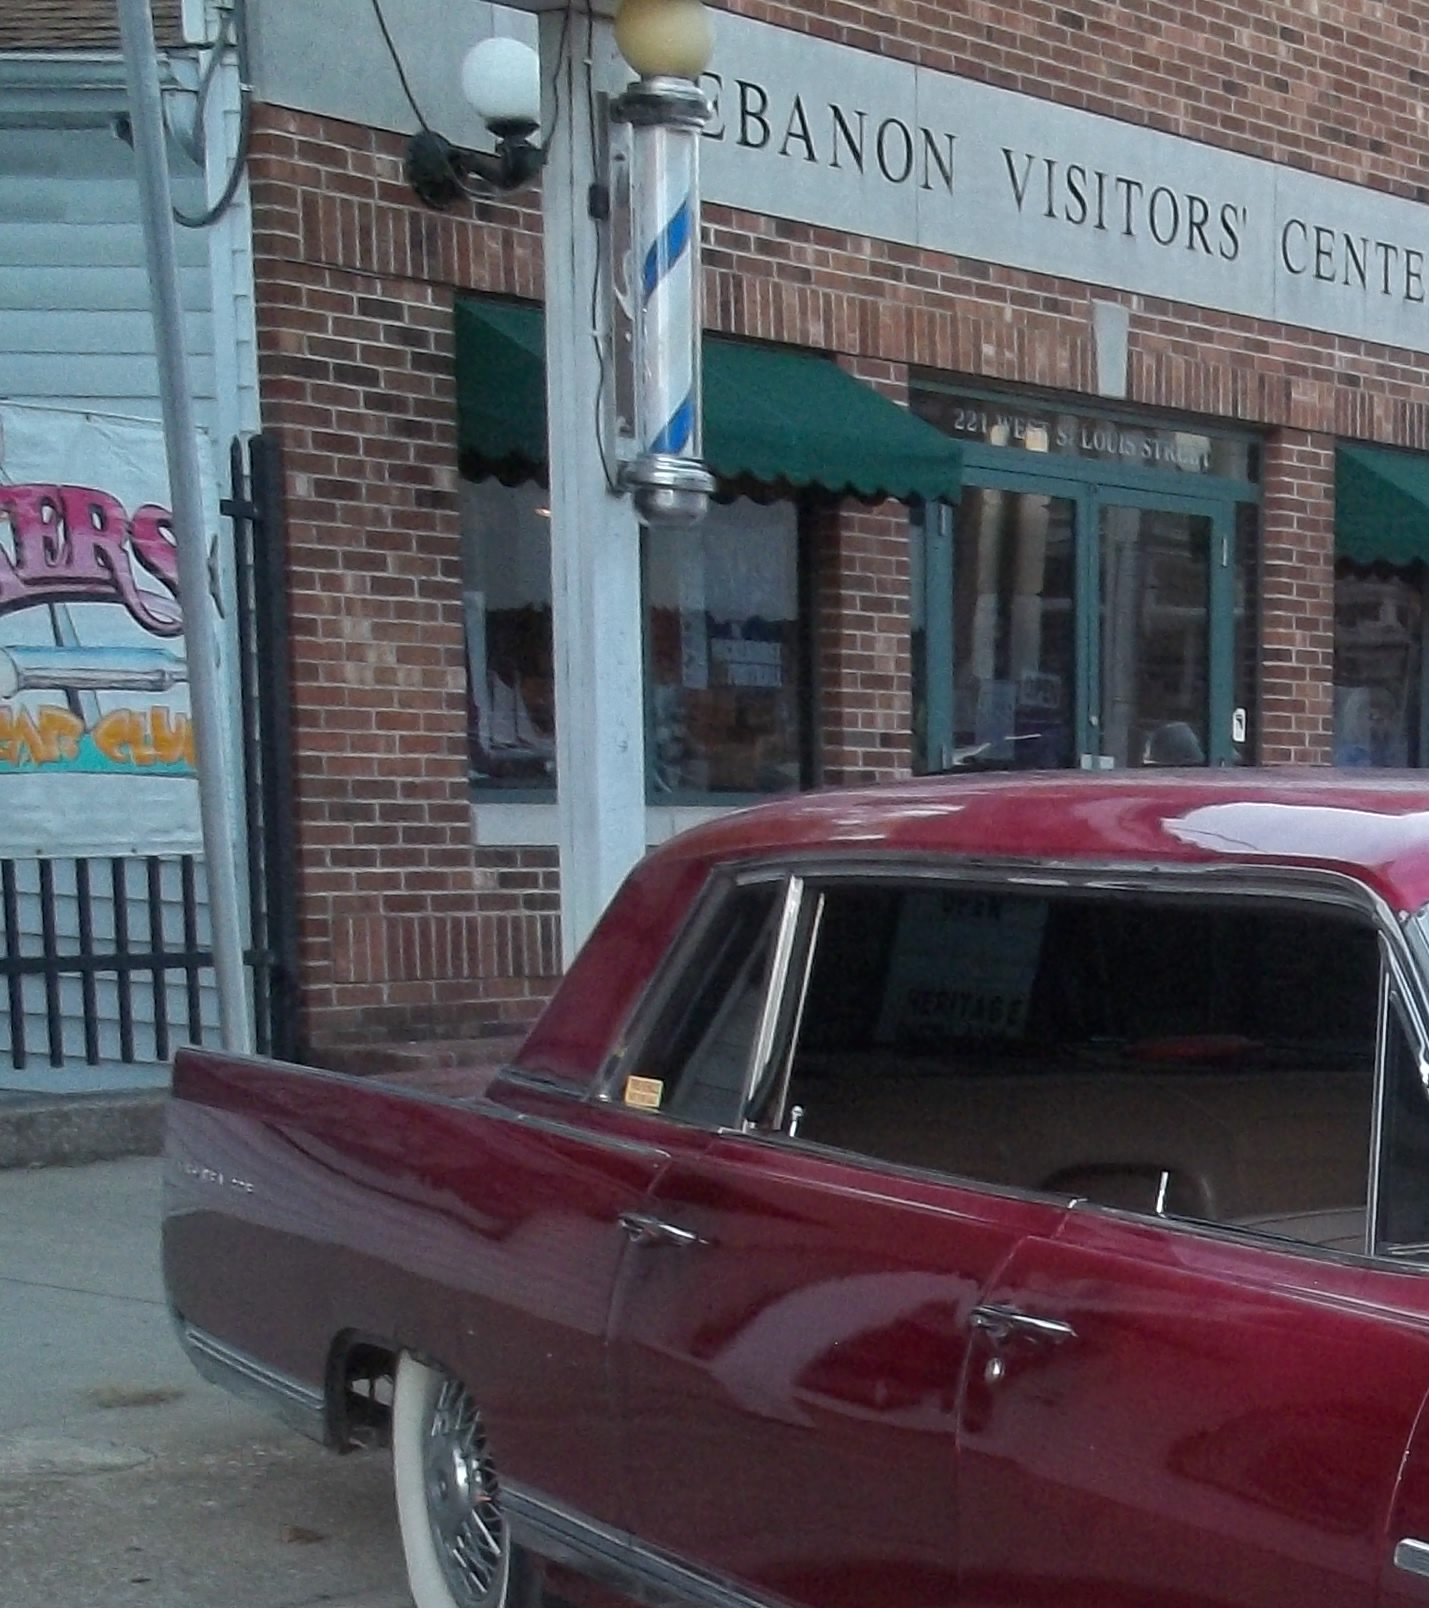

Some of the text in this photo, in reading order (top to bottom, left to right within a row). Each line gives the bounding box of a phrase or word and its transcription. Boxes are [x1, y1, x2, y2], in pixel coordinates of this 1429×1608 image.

[698, 70, 957, 196] EBANON
[1001, 147, 1248, 262] VISITORS'
[1082, 430, 1136, 456] LOUIS
[93, 706, 197, 768] CLU
